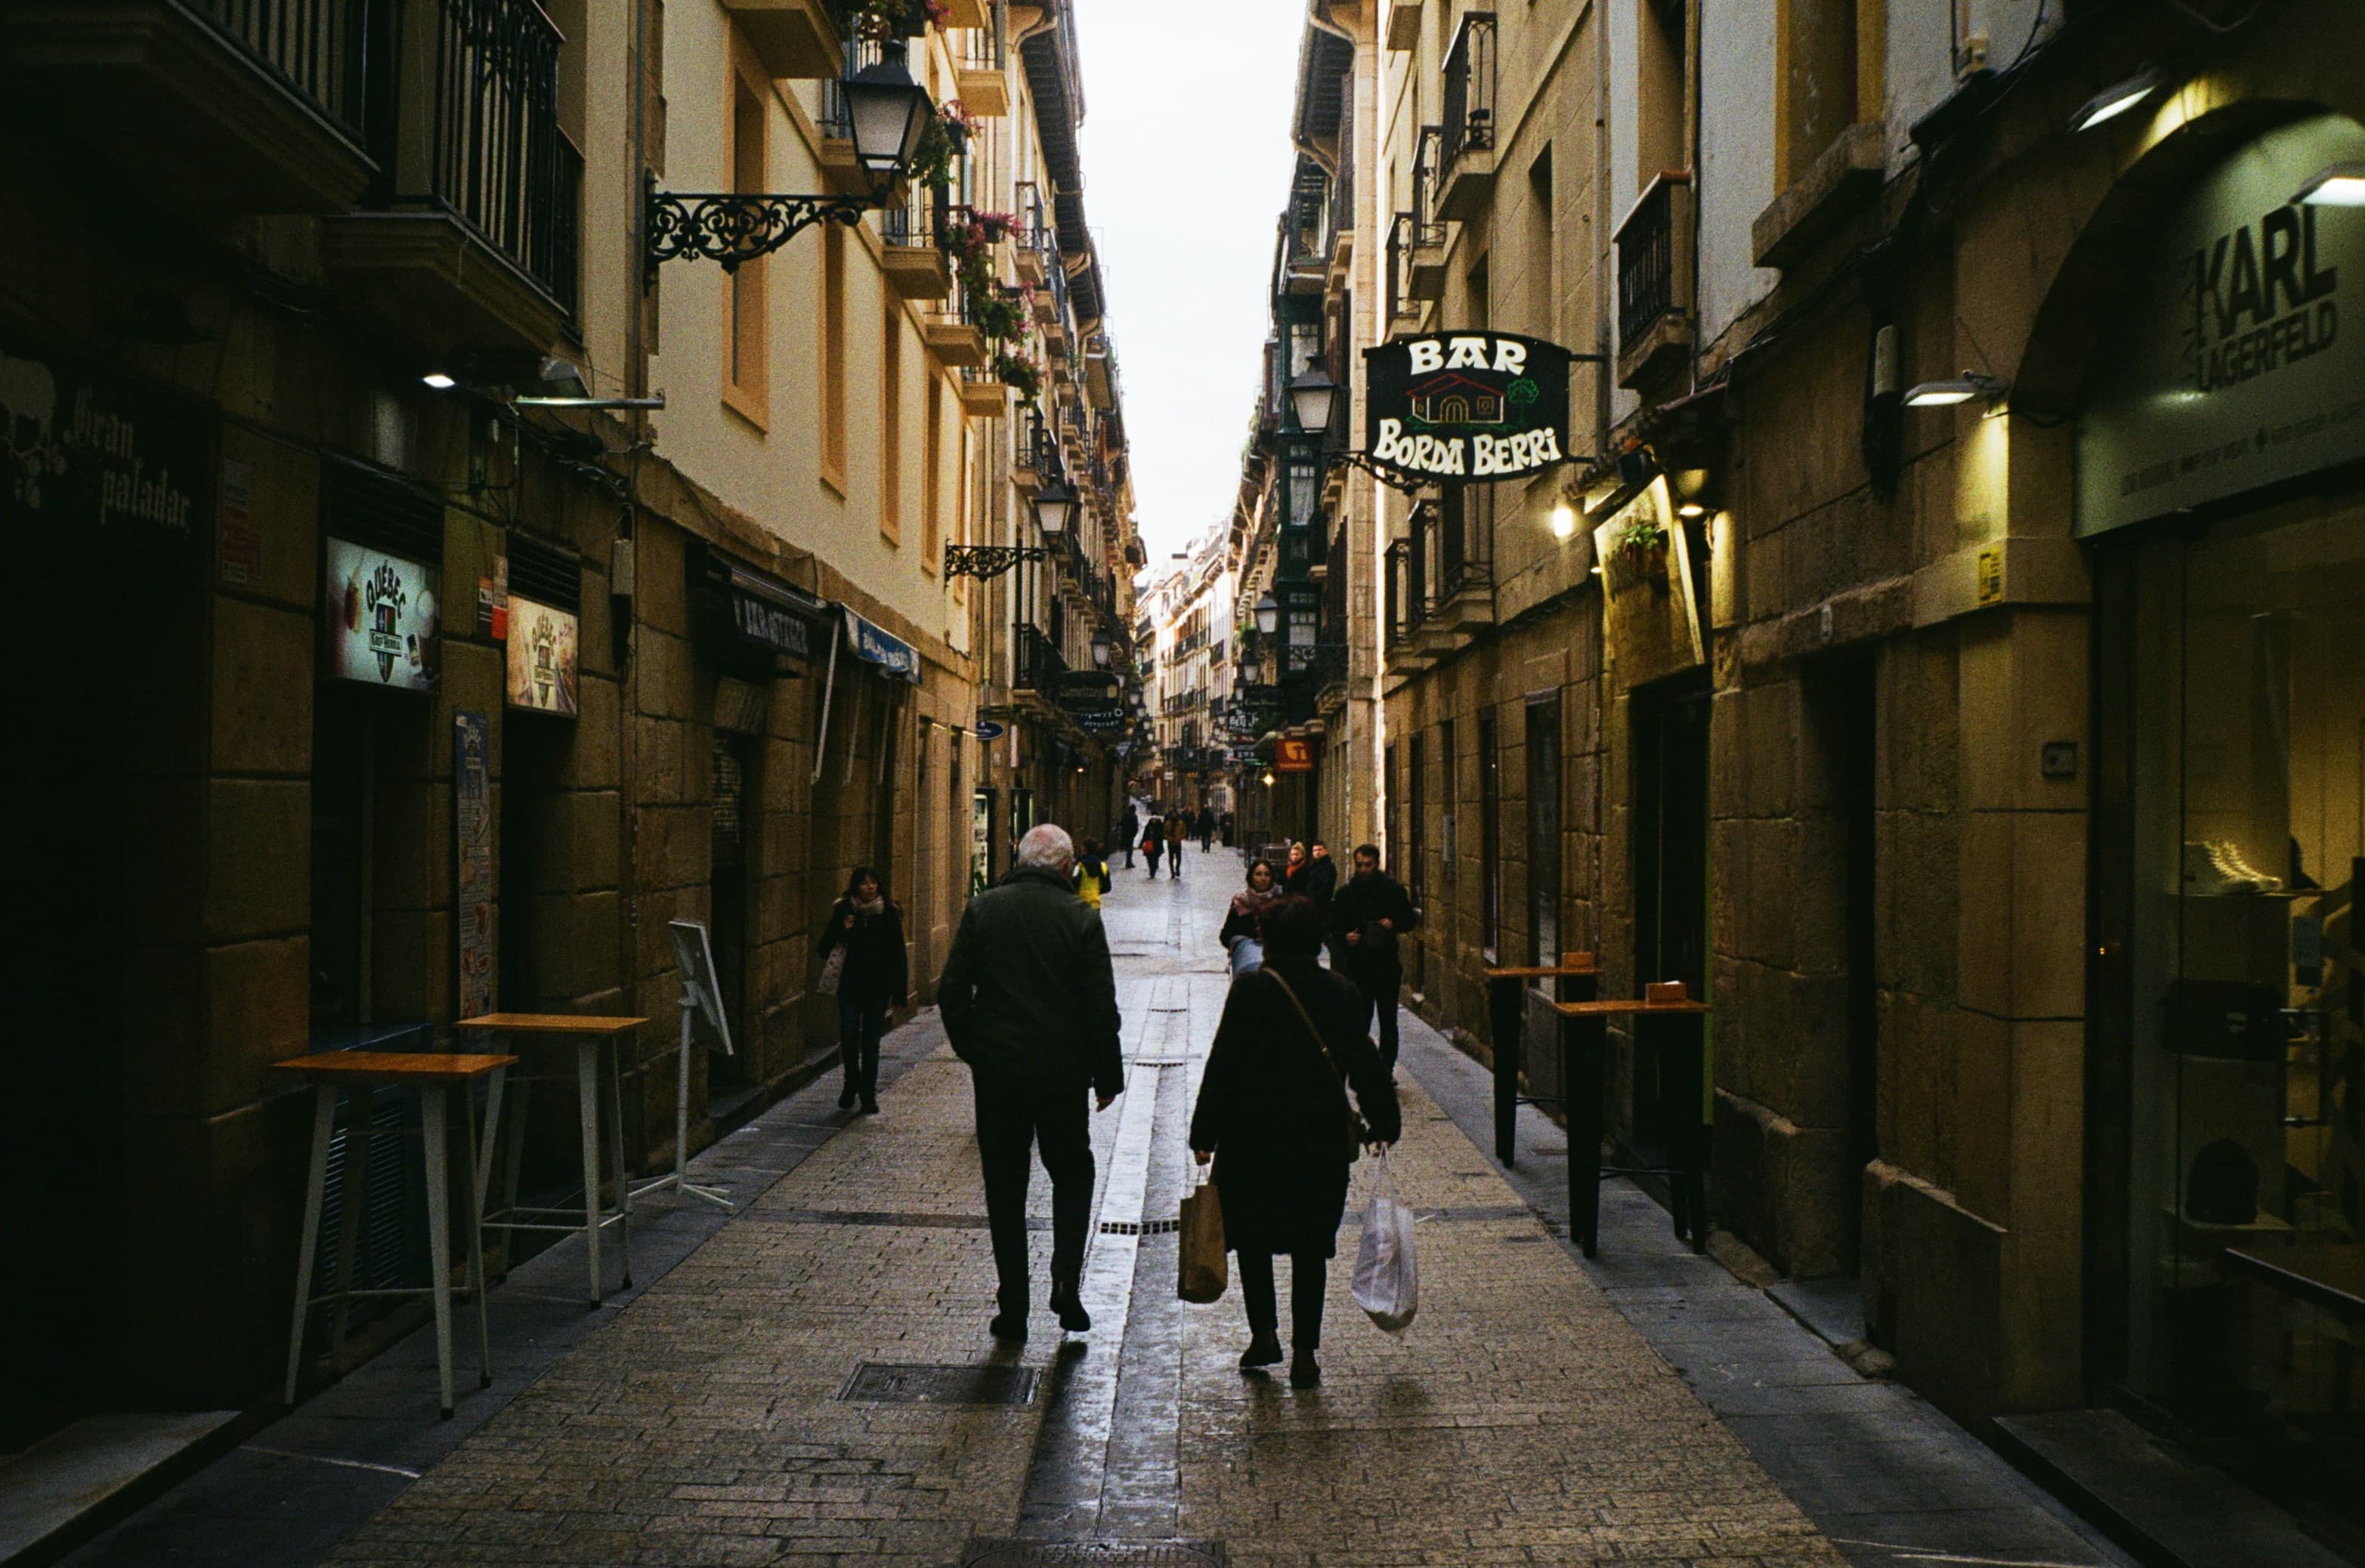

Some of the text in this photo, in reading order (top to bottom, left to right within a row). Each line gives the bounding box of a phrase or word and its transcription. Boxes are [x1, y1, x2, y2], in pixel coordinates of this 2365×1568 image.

[2194, 201, 2337, 348] KARL
[1408, 337, 1527, 376] BAR
[2197, 298, 2337, 392] LAGERFELD
[1372, 418, 1465, 475] BORDA
[98, 456, 191, 530] paladar
